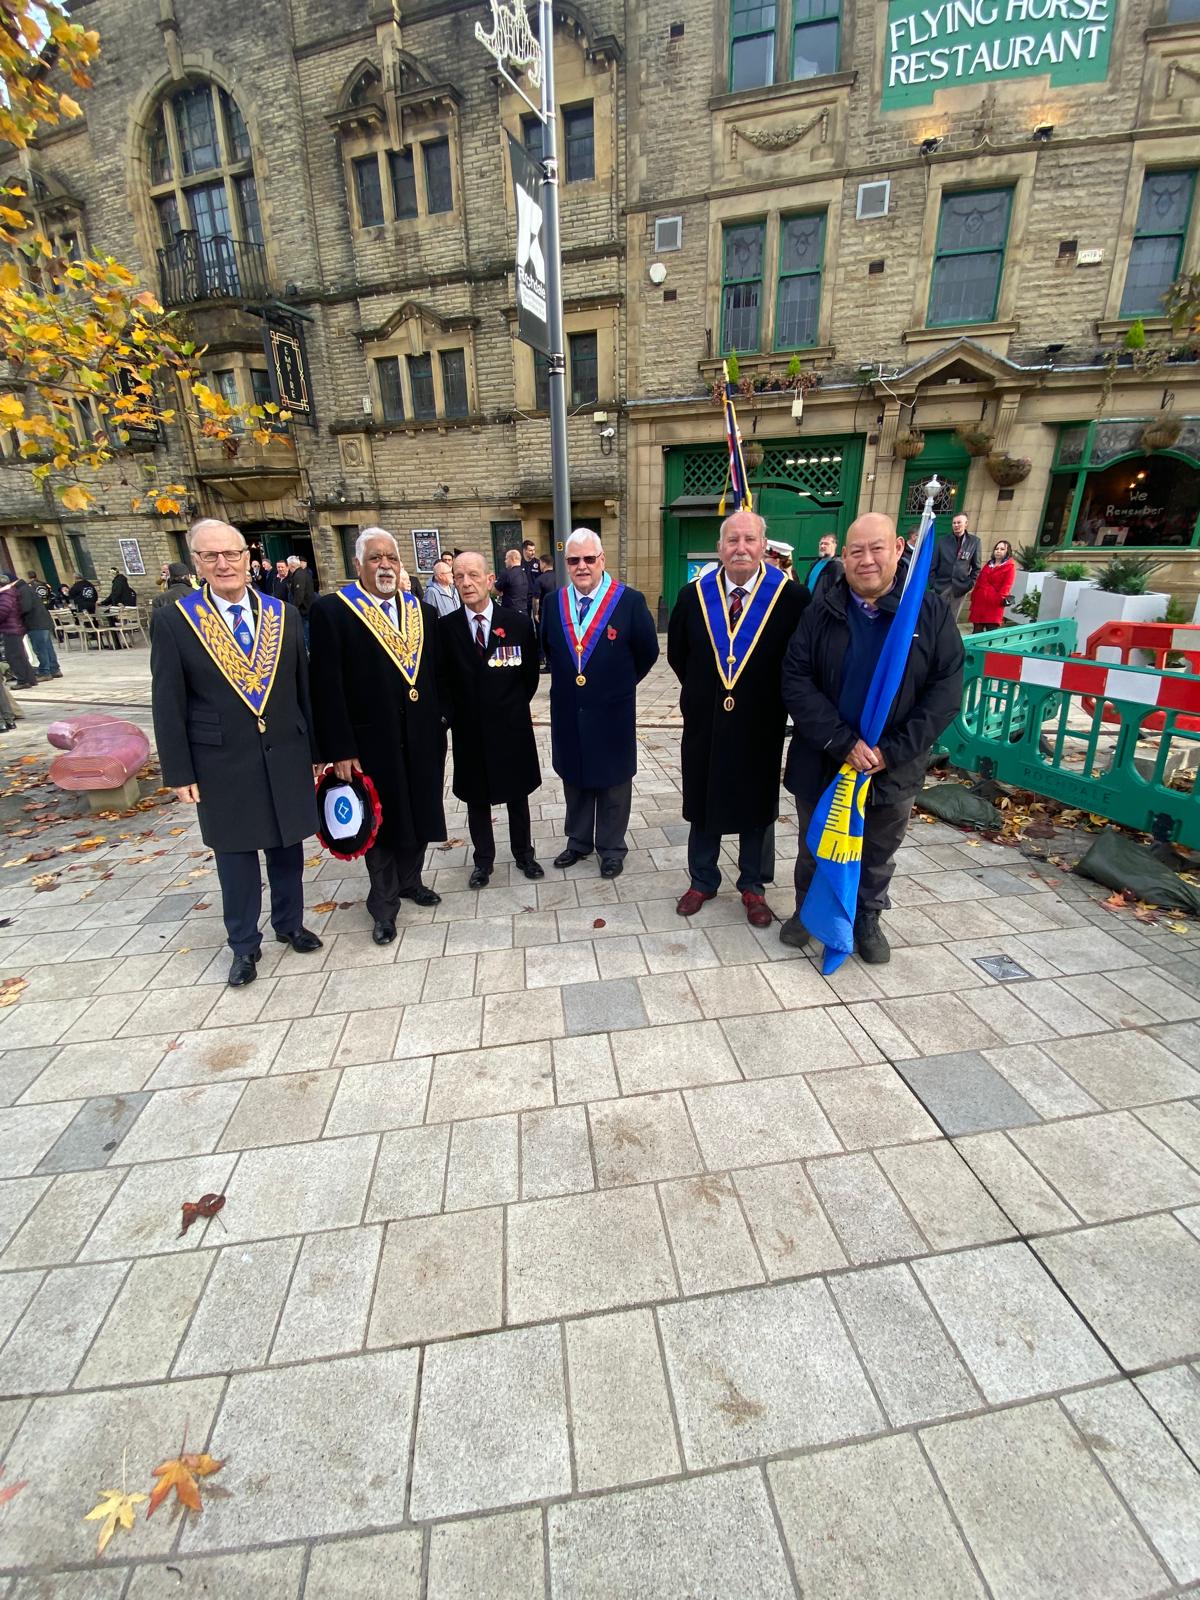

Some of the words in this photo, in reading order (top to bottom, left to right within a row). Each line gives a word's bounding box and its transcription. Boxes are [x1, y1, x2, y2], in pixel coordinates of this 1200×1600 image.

[889, 0, 999, 53] FLYING
[1005, 0, 1109, 21] HORSE
[889, 26, 1106, 87] RESTAURANT
[517, 265, 546, 300] Rochdale
[283, 346, 297, 399] EMPIRE
[1105, 504, 1165, 517] Remember
[1130, 490, 1148, 501] We
[1023, 767, 1112, 805] ROCHDALE
